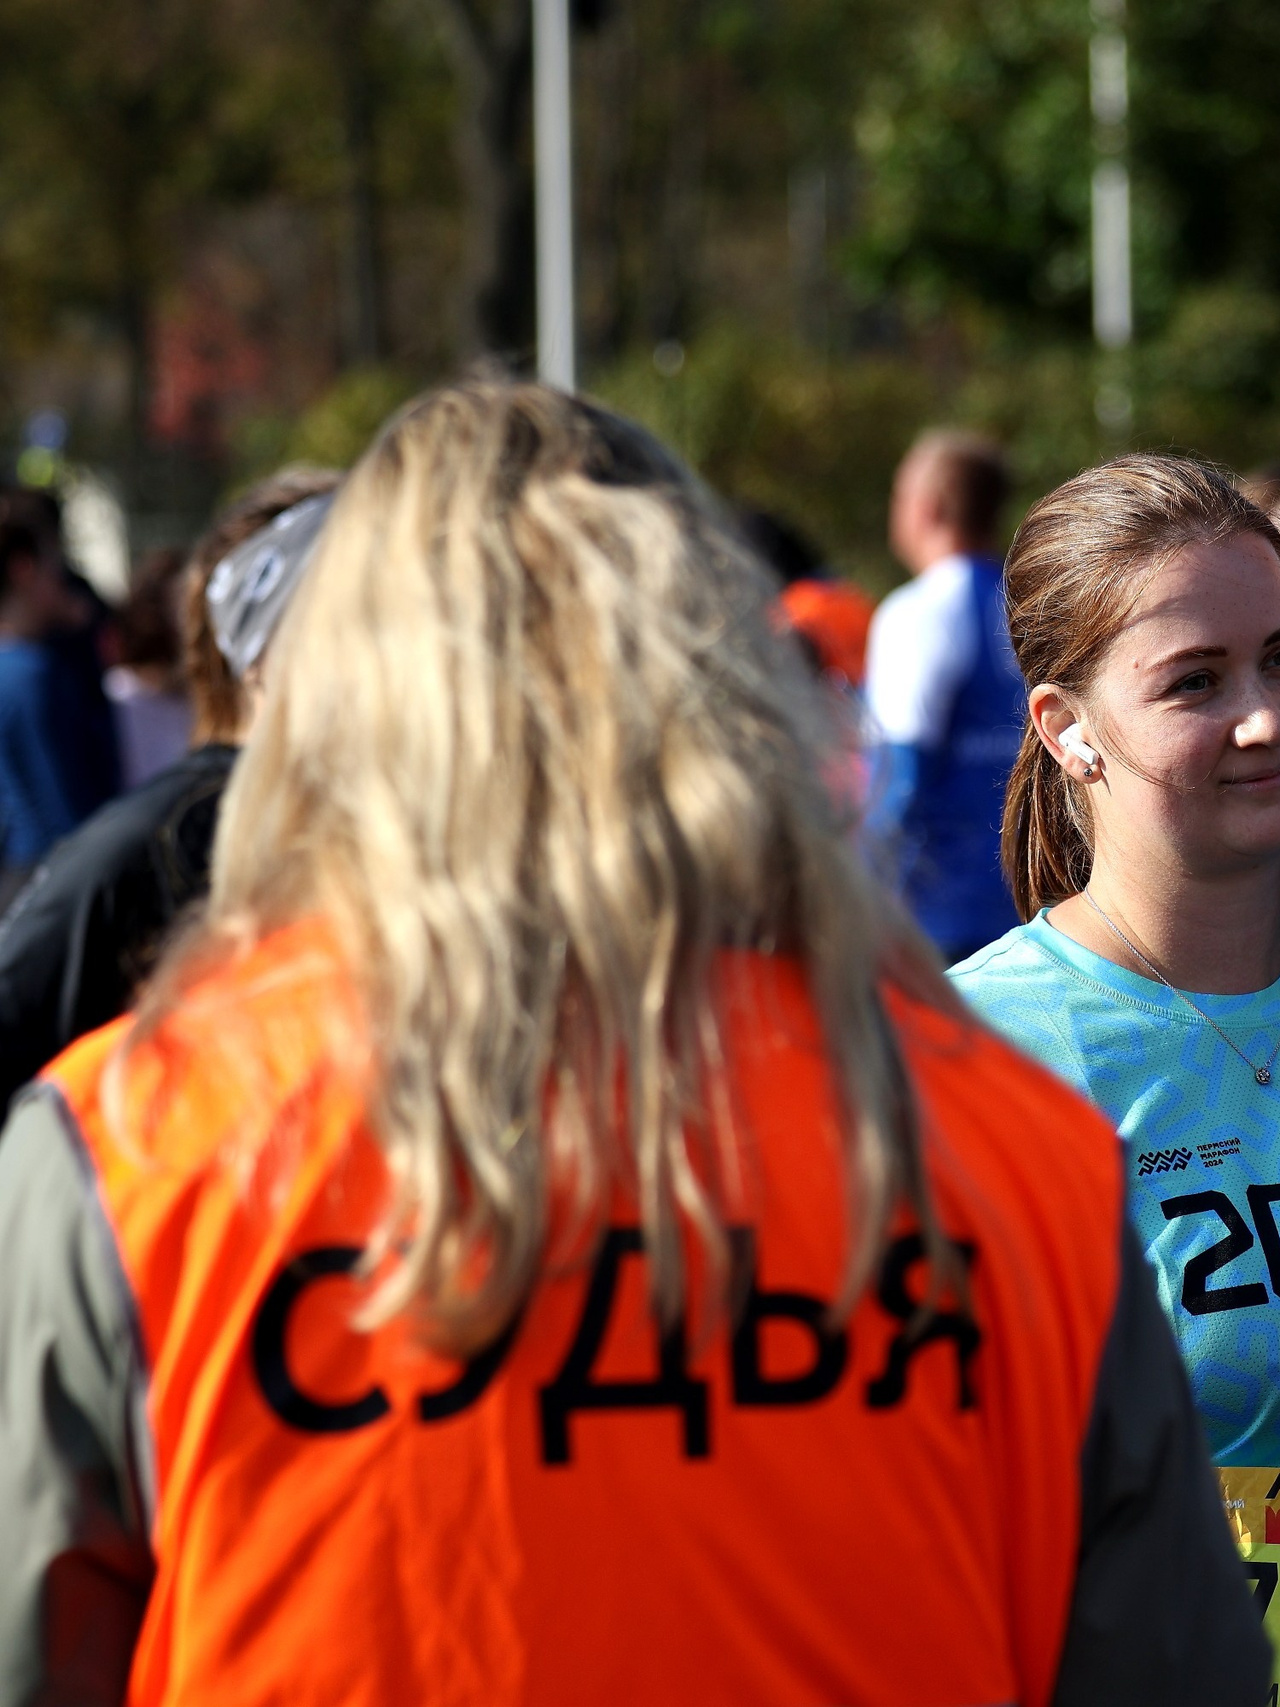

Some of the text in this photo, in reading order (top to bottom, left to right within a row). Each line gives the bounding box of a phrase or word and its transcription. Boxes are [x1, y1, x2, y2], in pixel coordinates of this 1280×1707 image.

[1196, 1137, 1242, 1152] ПЕРМСКИЙ
[1200, 1147, 1241, 1160] МАРАФОН
[1203, 1158, 1224, 1168] 2024
